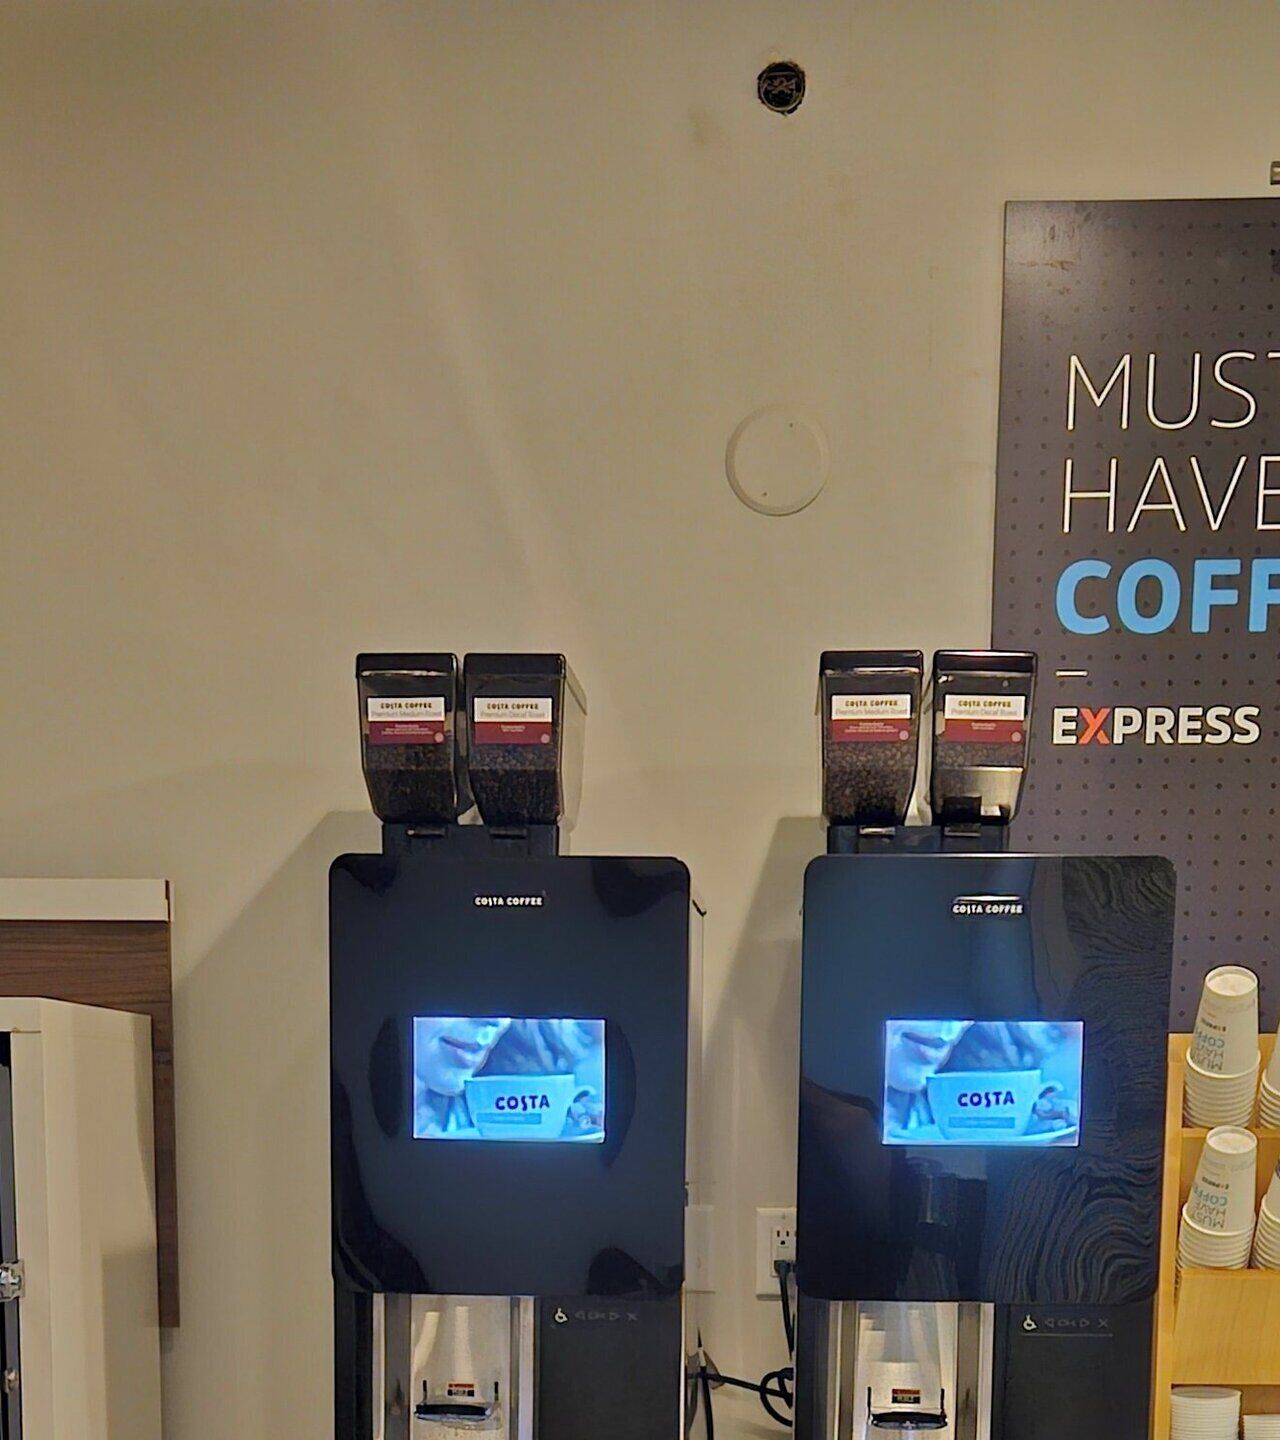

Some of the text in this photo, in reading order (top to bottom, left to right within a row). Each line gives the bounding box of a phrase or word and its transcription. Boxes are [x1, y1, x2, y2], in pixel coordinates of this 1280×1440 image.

[1052, 705, 1261, 745] EXPRESS
[474, 896, 543, 907] COSTA COFFEE
[952, 904, 1023, 915] COSTA COFFEE
[494, 1094, 550, 1112] COSTA
[957, 1090, 1015, 1108] COSTA
